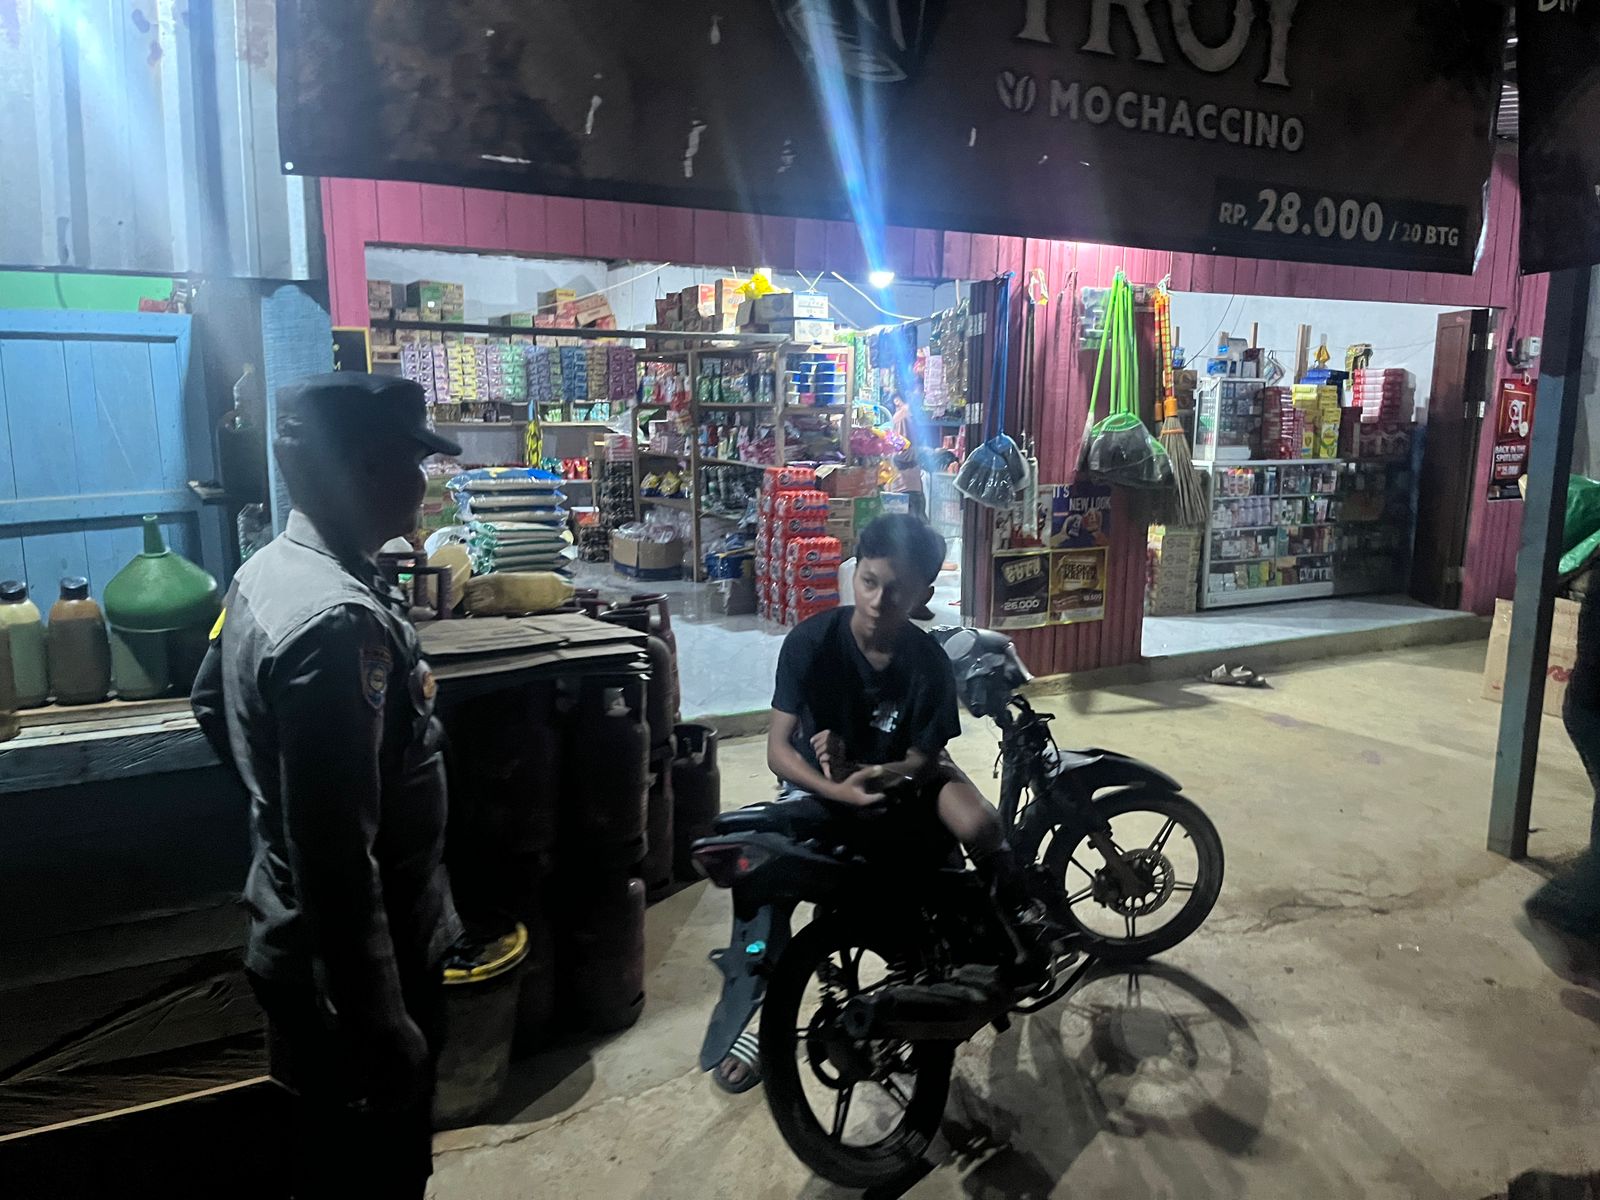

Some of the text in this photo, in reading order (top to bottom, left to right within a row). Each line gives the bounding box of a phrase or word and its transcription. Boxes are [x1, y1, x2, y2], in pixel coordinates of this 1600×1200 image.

[1050, 79, 1304, 151] MOCHACCINO
[1218, 201, 1248, 227] RP.
[1252, 188, 1384, 243] 28.000
[1424, 225, 1459, 247] BTG
[1052, 484, 1070, 499] IT'S
[1069, 496, 1111, 512] NEW LOOK
